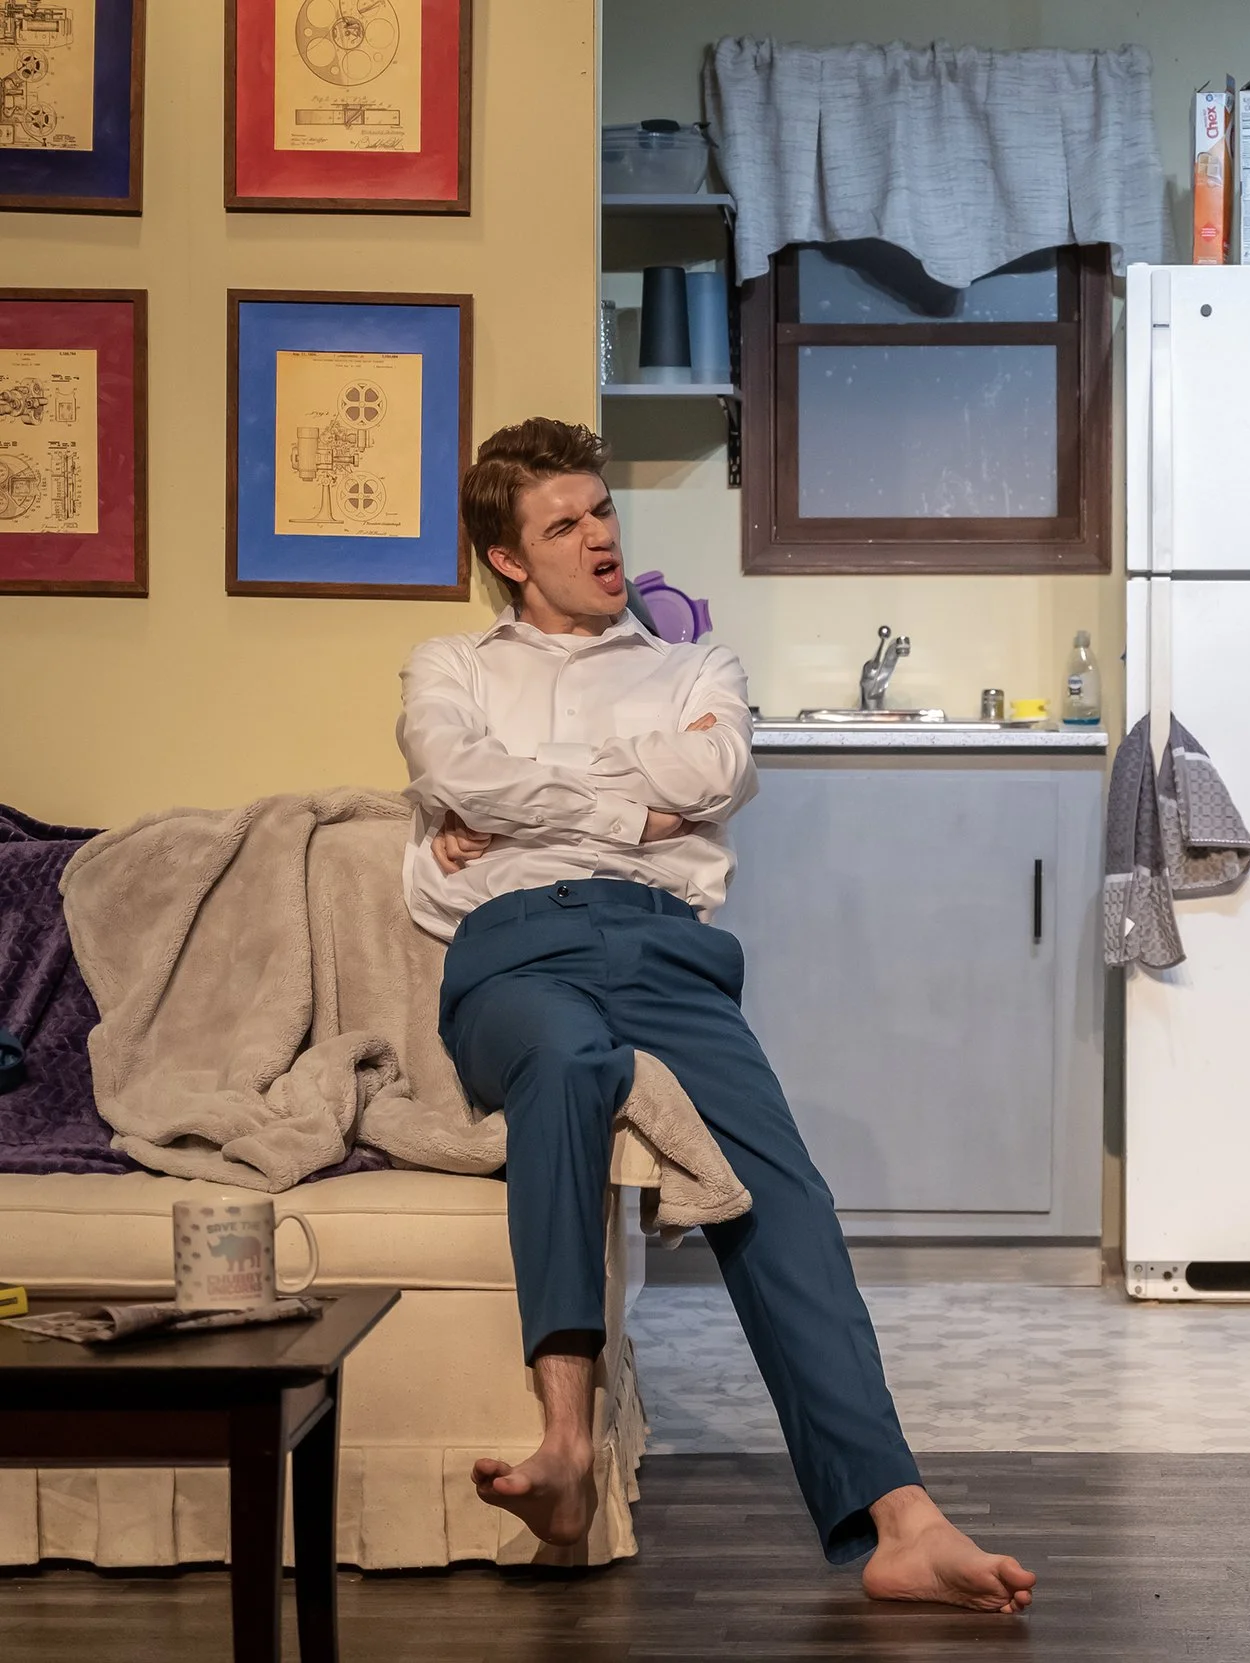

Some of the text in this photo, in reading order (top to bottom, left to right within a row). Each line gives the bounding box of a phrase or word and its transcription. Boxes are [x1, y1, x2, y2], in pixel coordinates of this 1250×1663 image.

[1206, 106, 1219, 139] Chex
[206, 1221, 261, 1234] SAVE THE
